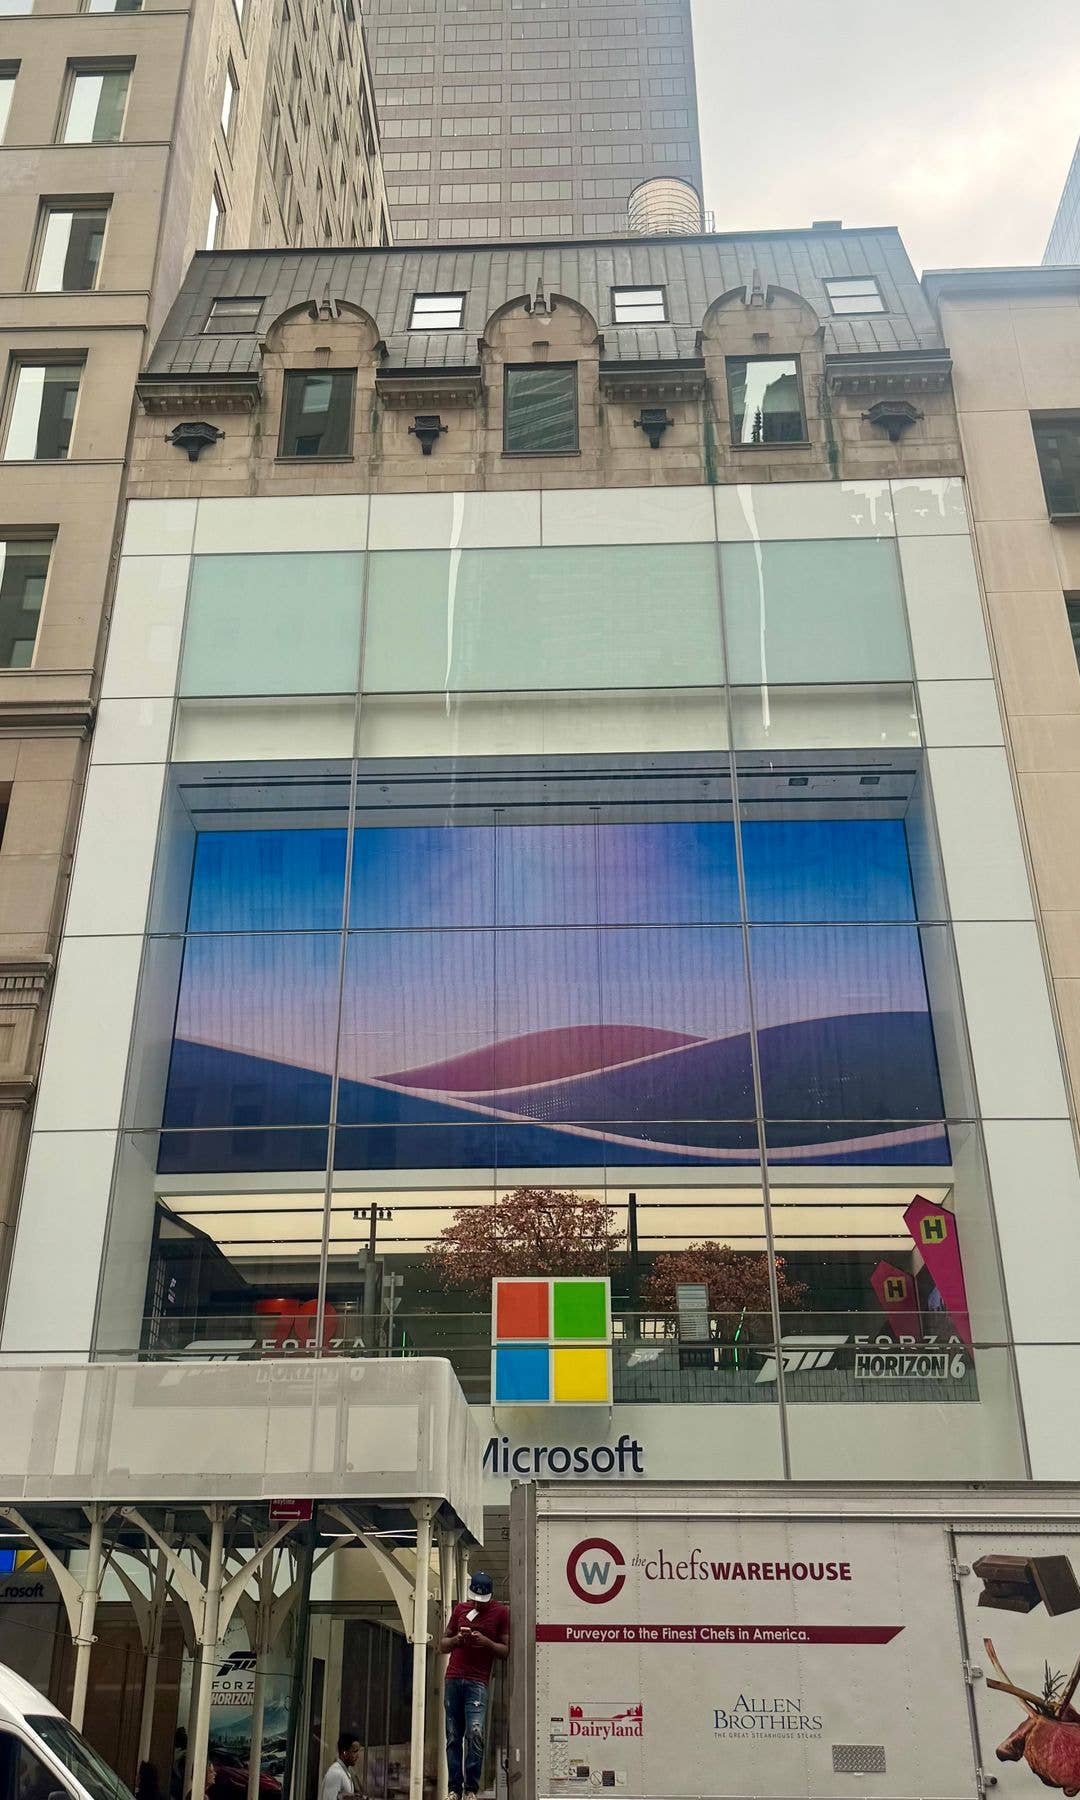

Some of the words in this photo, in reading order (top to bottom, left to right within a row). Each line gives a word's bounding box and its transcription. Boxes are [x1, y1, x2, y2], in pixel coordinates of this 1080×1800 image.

[924, 1219, 944, 1239] H
[887, 1280, 904, 1298] H
[261, 1338, 368, 1354] FORZA
[854, 1335, 965, 1350] FORZA
[856, 1354, 947, 1378] HORIZON
[950, 1354, 966, 1379] 6
[711, 1562, 852, 1581] WAREHOUSE
[0, 1583, 44, 1598] rosoft
[566, 1627, 620, 1642] Purveyor
[623, 1627, 636, 1640] to
[639, 1627, 659, 1640] the
[662, 1627, 697, 1640] Finest
[700, 1627, 735, 1640] Chefs
[738, 1628, 750, 1640] in
[753, 1628, 810, 1641] America.
[211, 1681, 256, 1690] FORZ
[733, 1694, 802, 1713] ALLEN
[713, 1709, 823, 1730] BROTHERS
[569, 1721, 644, 1740] Dairyland
